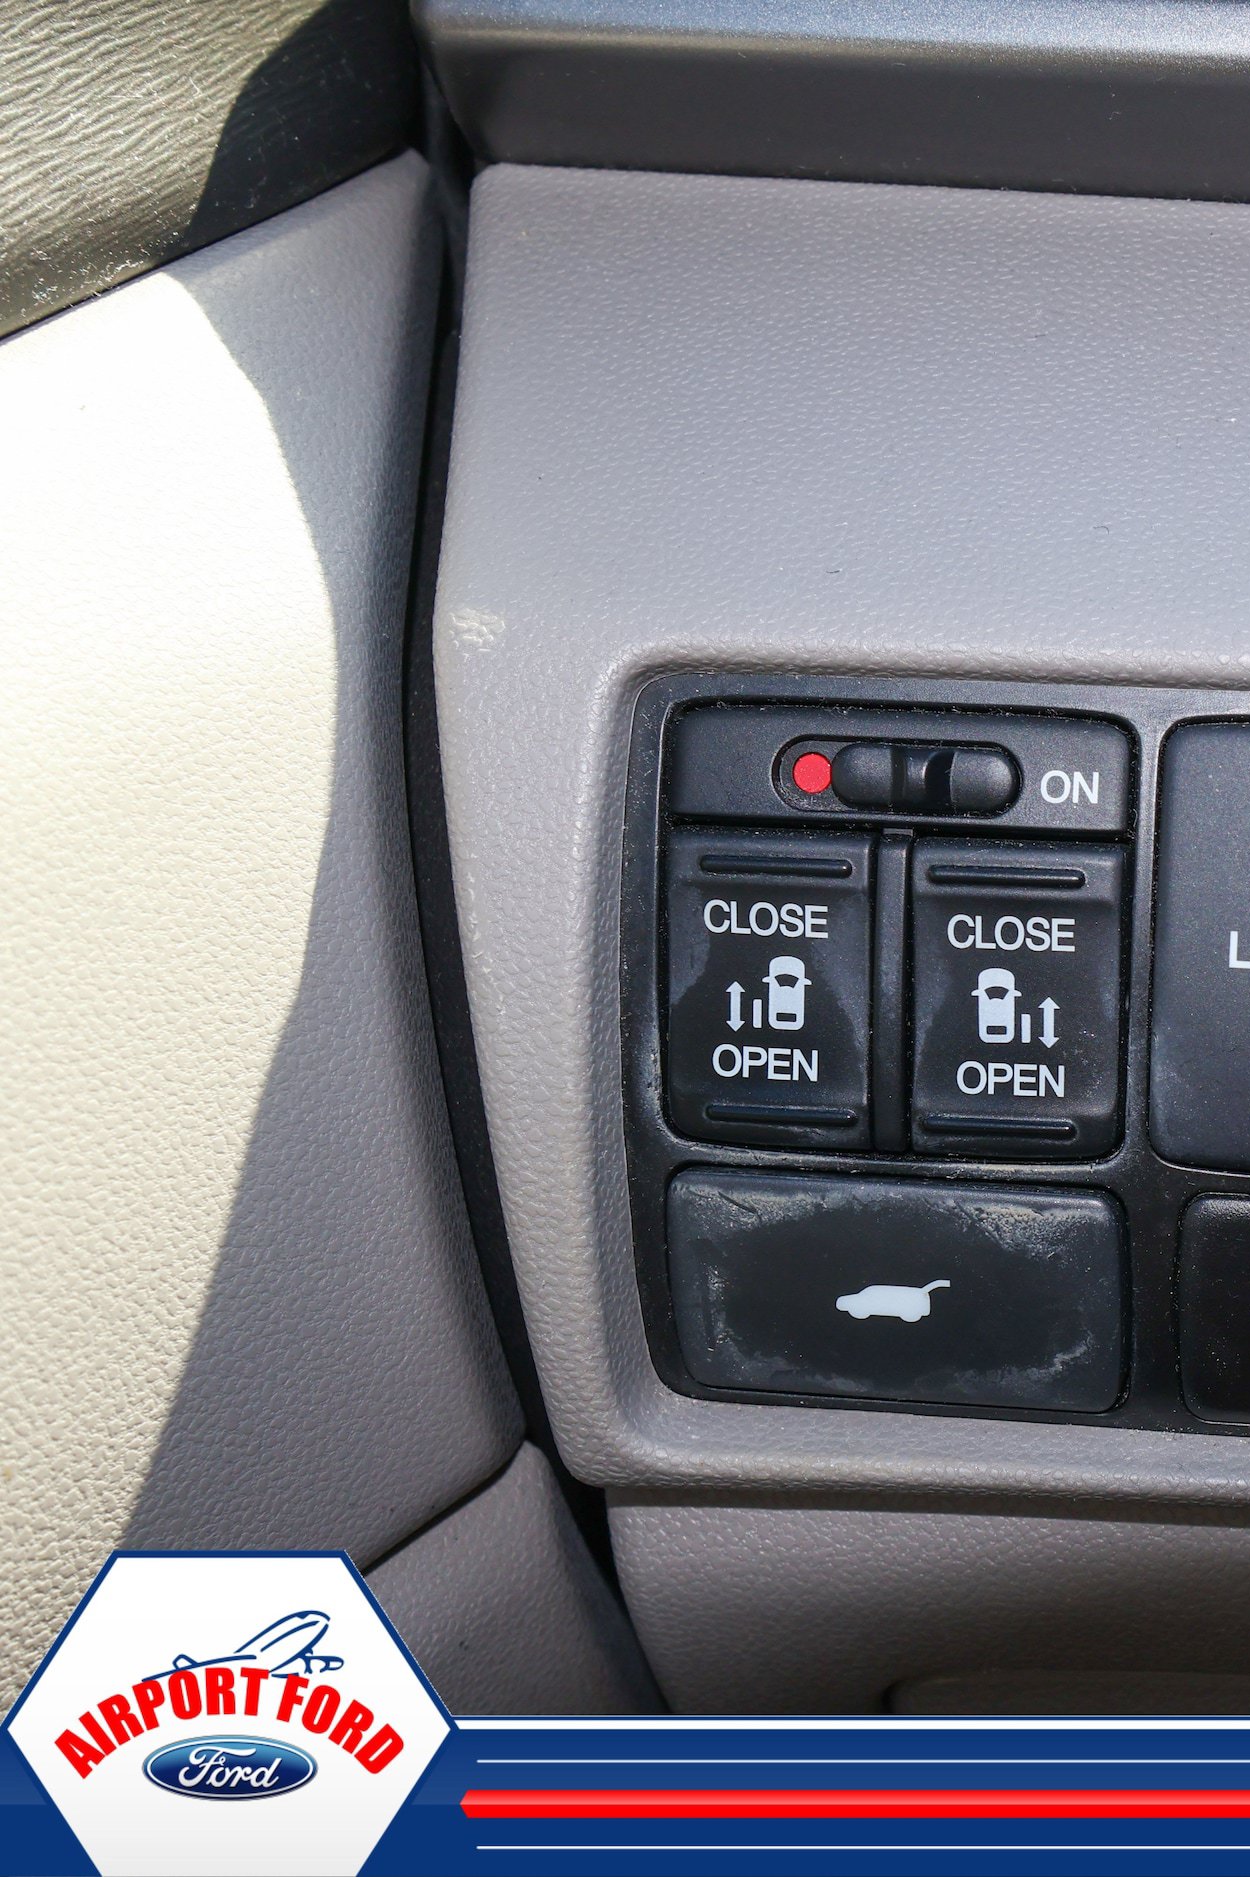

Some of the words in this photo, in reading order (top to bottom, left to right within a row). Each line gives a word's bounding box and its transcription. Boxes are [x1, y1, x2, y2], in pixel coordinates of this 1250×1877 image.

[1040, 770, 1099, 804] ON
[703, 899, 829, 939] CLOSE
[947, 914, 1076, 952] CLOSE
[712, 1043, 819, 1082] OPEN
[956, 1060, 1066, 1098] OPEN
